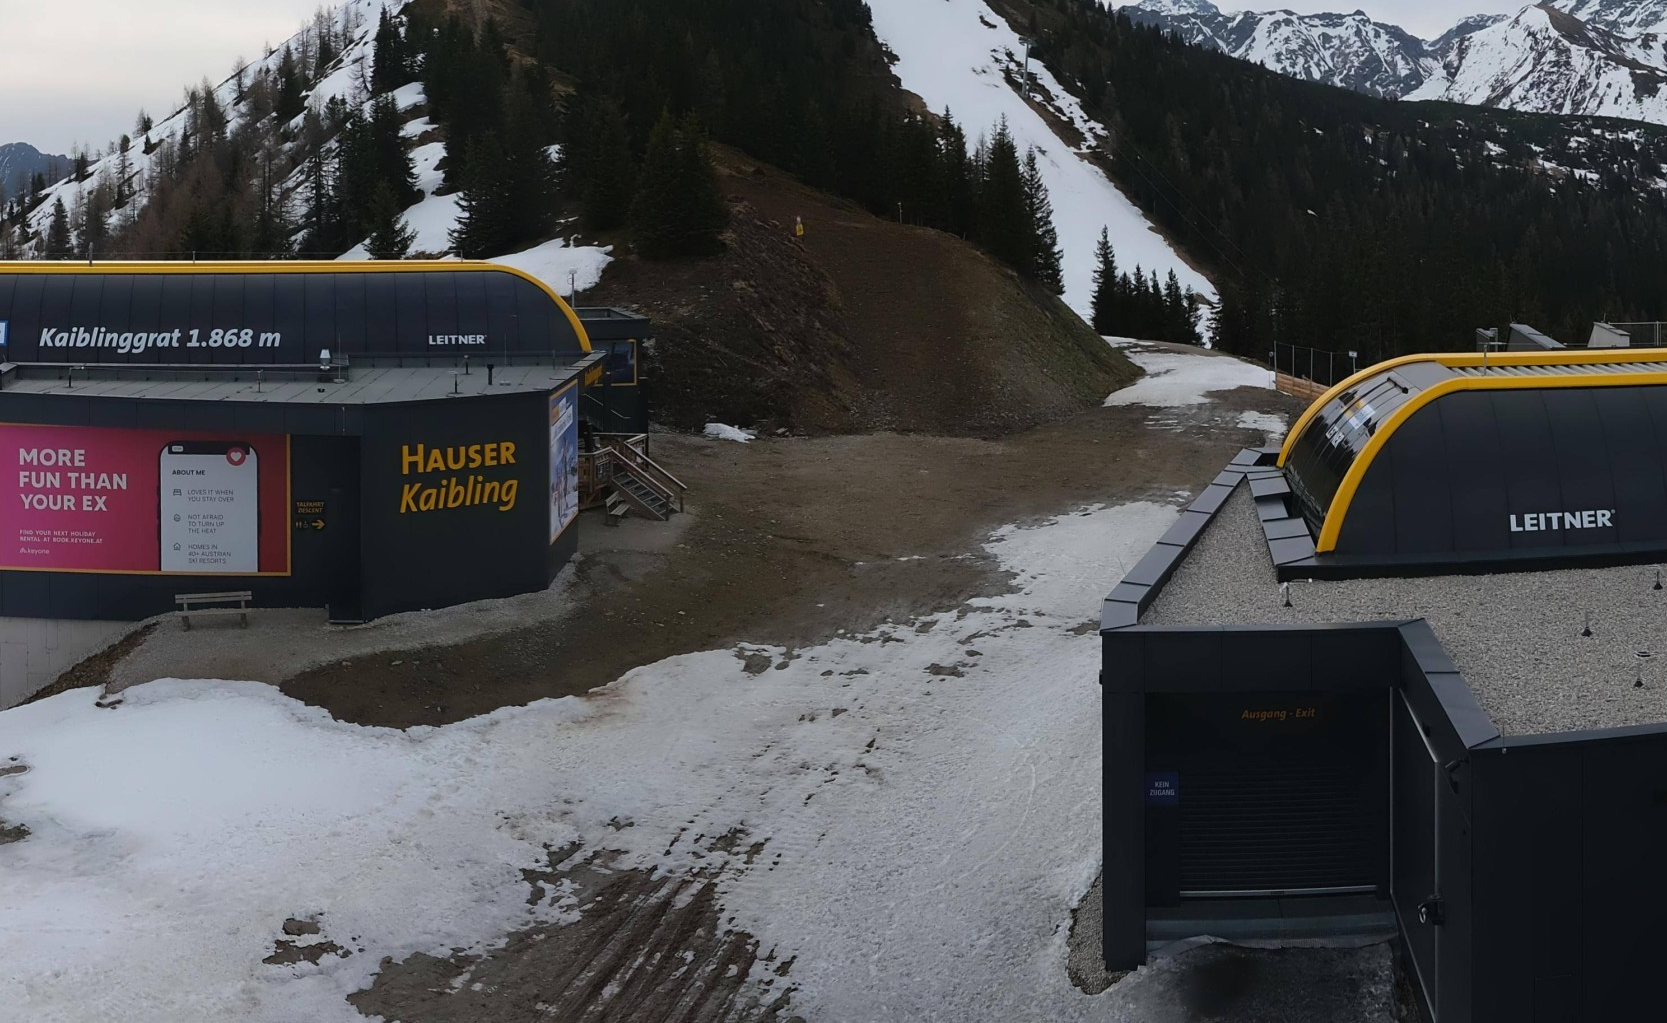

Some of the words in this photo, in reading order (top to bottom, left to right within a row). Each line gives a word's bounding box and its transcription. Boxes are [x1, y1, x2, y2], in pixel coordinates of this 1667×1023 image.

[39, 326, 181, 354] Kaiblinggrat
[186, 328, 254, 348] 1.868
[258, 331, 281, 347] m
[19, 448, 86, 467] MORE
[401, 441, 516, 475] HAUSER
[19, 471, 60, 488] FUN
[67, 473, 127, 490] THAN
[20, 493, 76, 511] YOUR
[82, 495, 108, 511] EX
[400, 475, 518, 514] Kaibling
[28, 547, 50, 555] keyone
[1241, 709, 1287, 722] Ausgang
[1295, 707, 1316, 718] Exit
